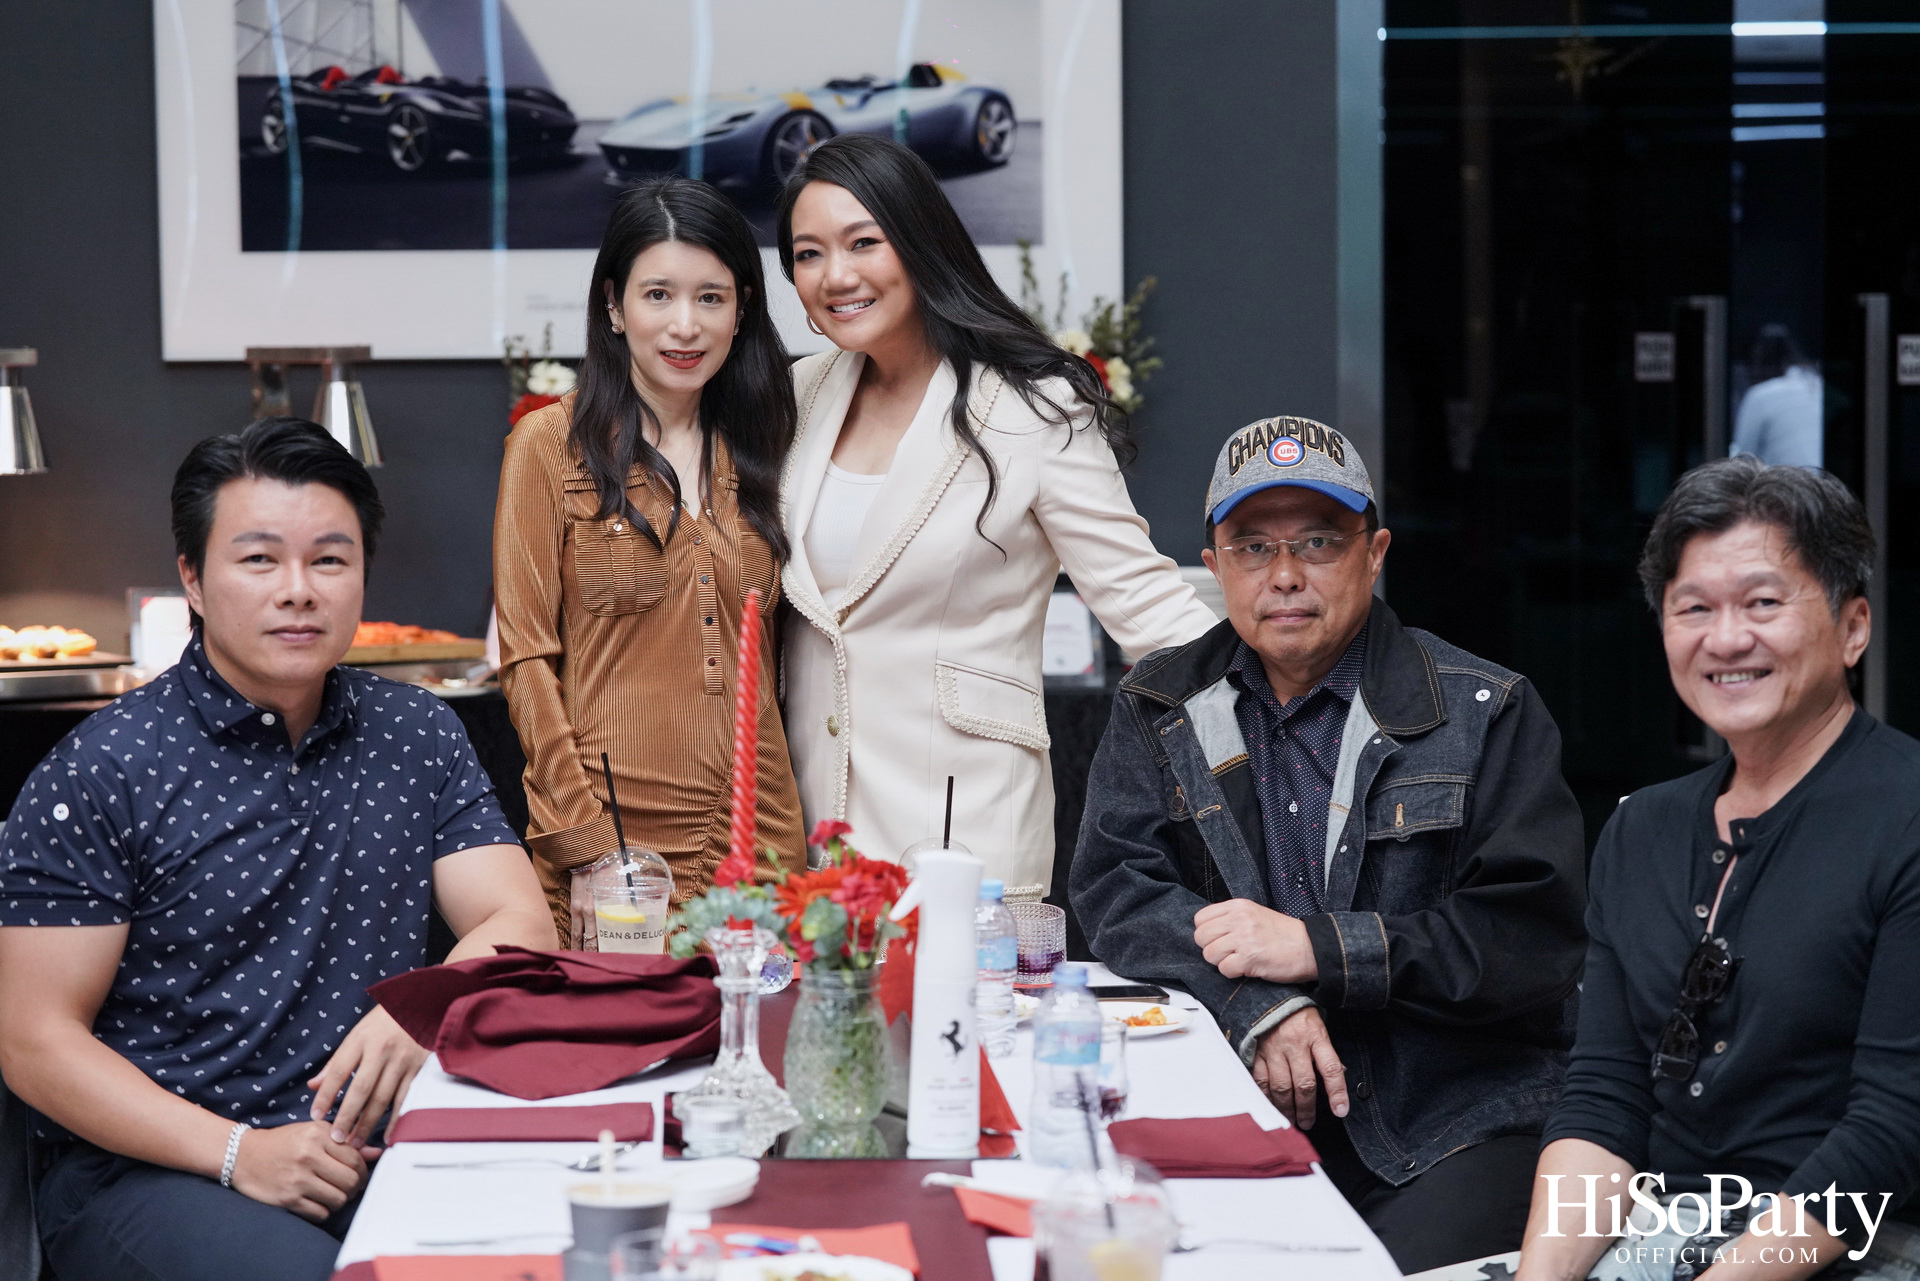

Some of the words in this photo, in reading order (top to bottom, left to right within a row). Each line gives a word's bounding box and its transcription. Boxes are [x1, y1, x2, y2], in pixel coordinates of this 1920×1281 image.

[1228, 418, 1345, 476] CHAMPIONS
[599, 929, 623, 939] DEAN
[624, 932, 632, 940] &
[633, 928, 665, 940] DELUC
